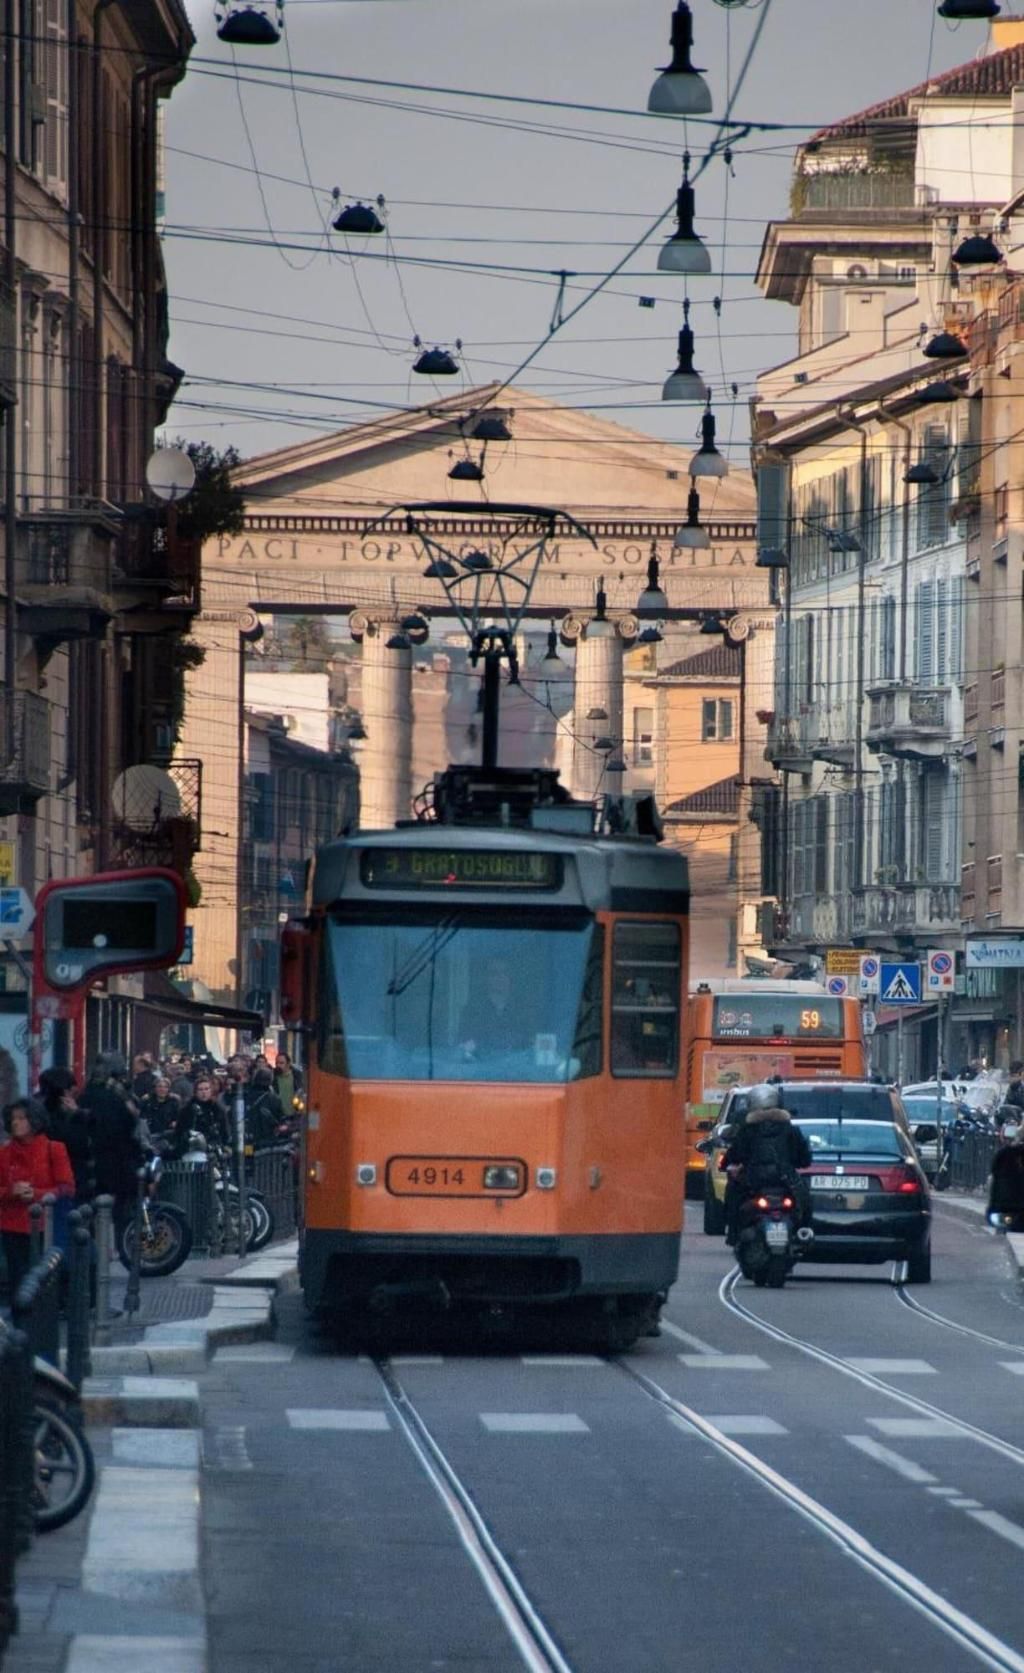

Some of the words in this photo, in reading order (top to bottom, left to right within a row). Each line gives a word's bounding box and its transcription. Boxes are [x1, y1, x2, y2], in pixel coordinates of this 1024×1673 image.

[217, 538, 298, 560] PACI
[801, 1010, 820, 1028] 59
[407, 1167, 465, 1185] 4914
